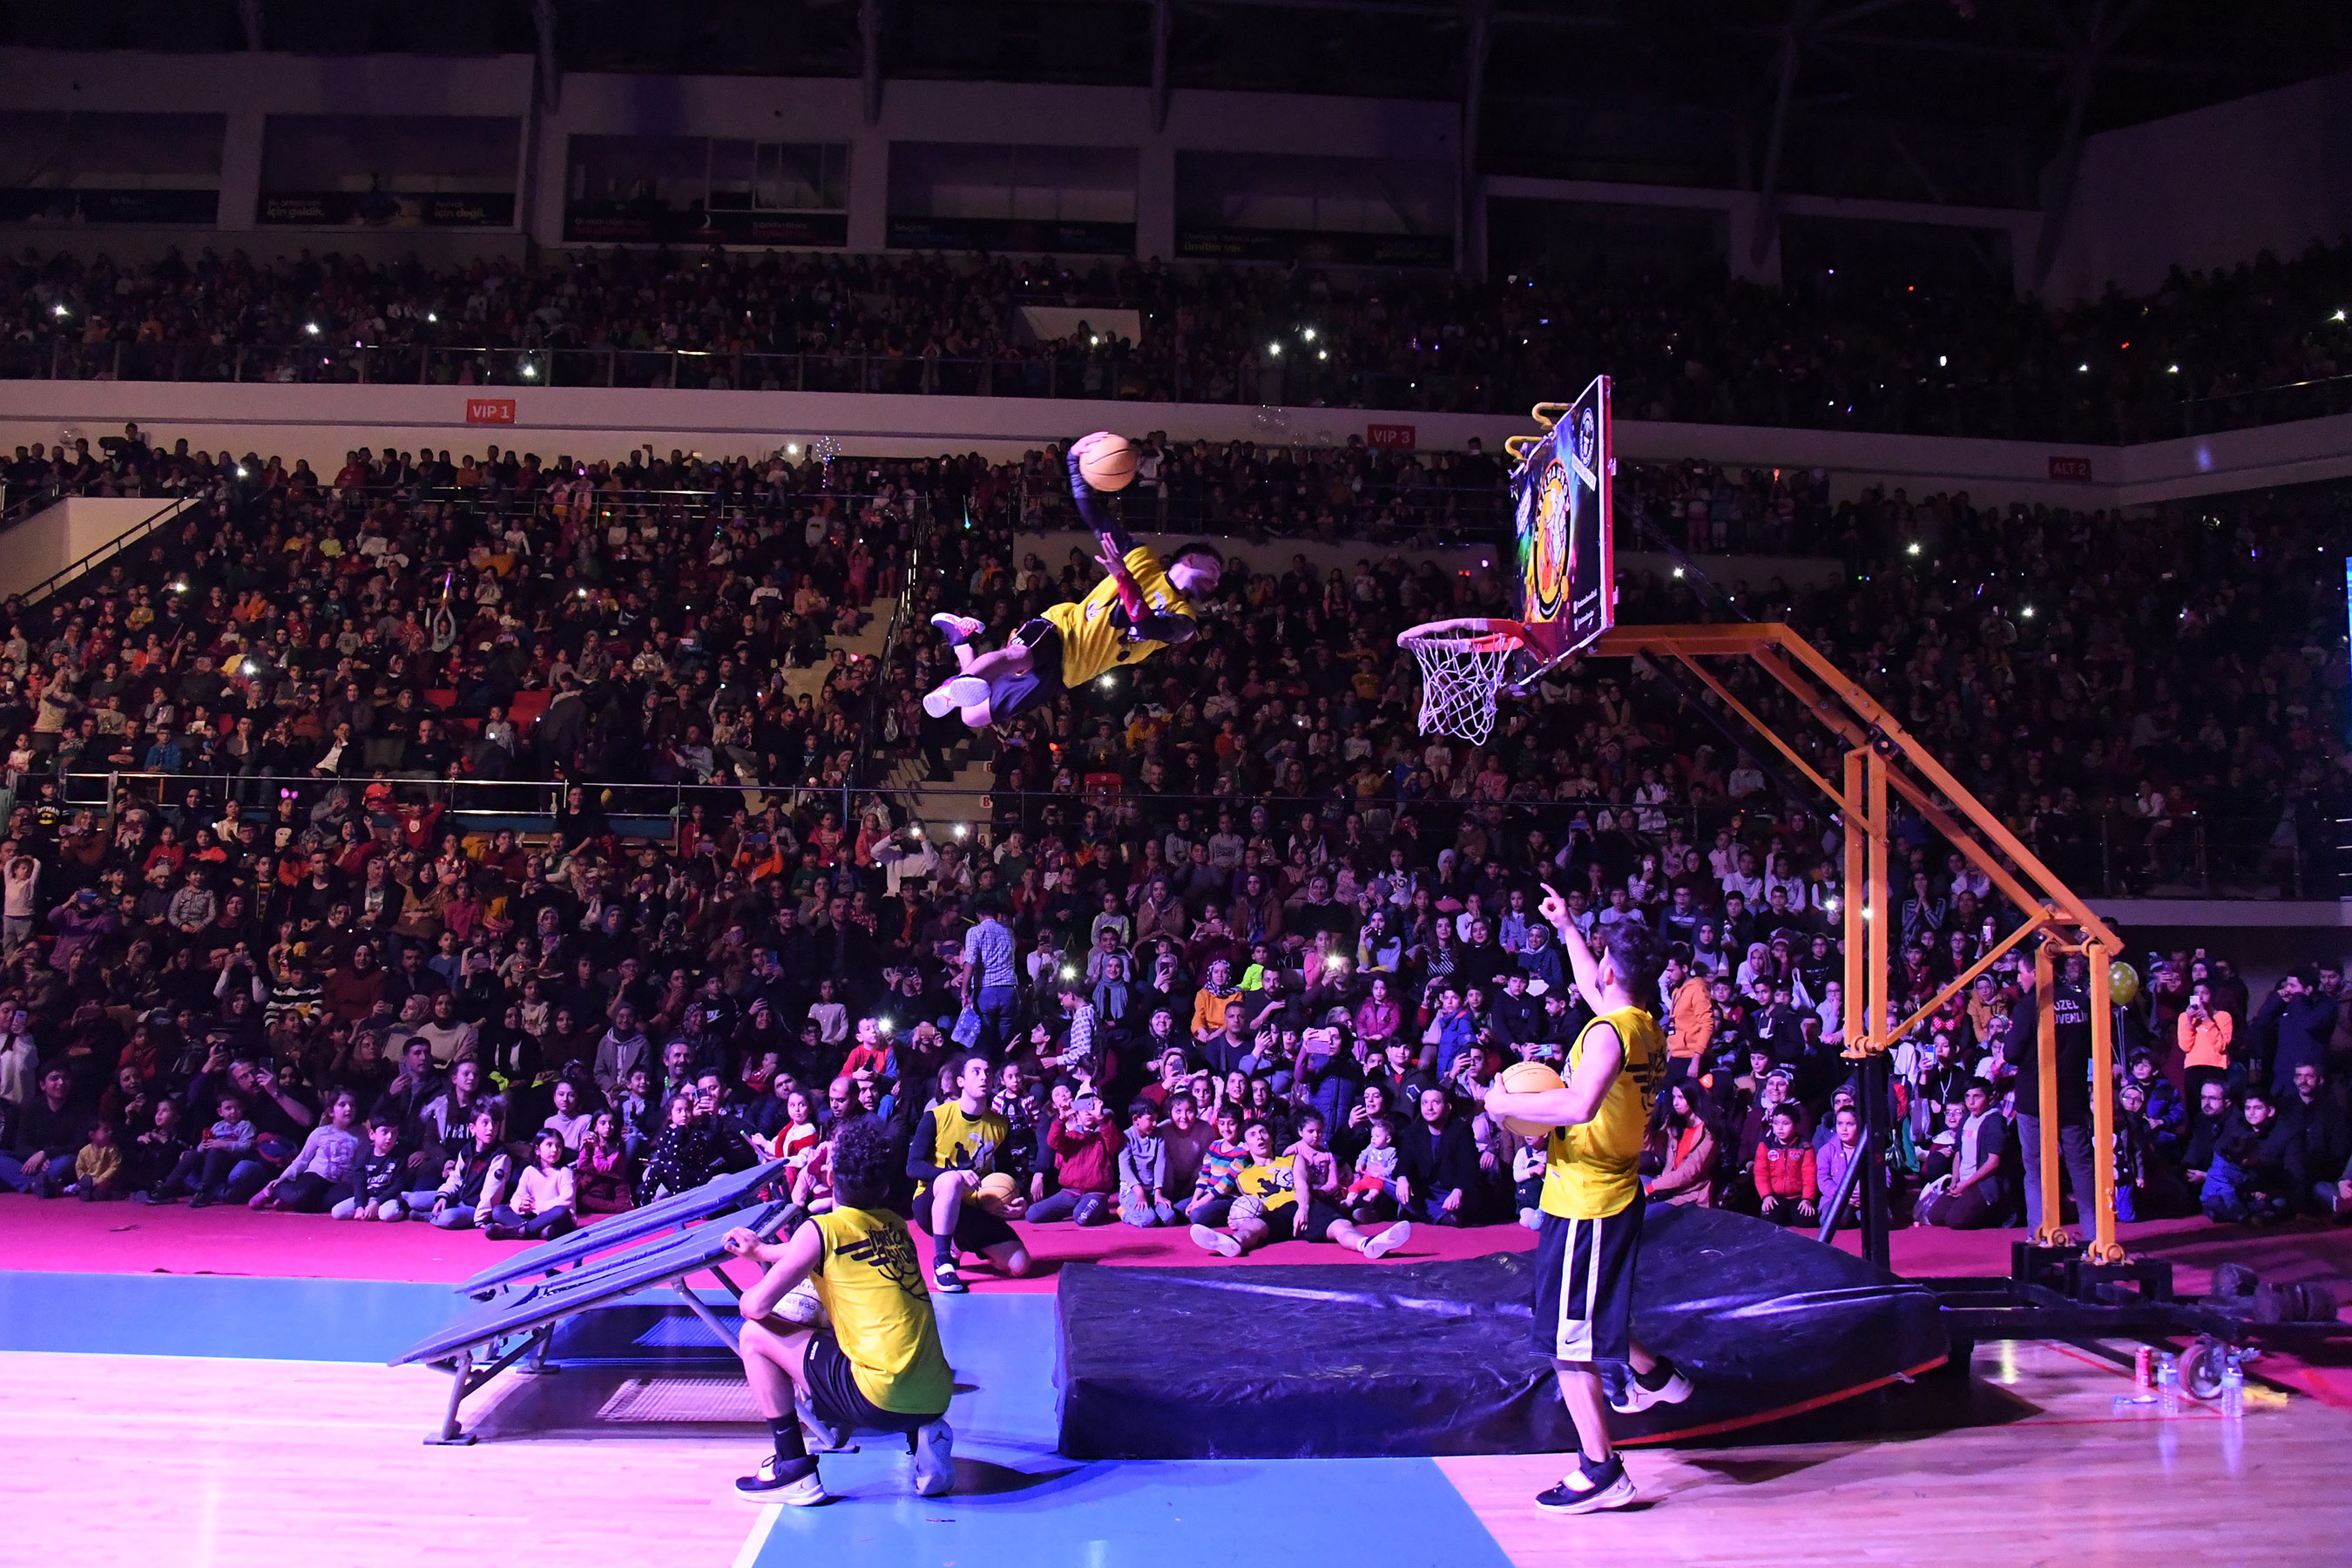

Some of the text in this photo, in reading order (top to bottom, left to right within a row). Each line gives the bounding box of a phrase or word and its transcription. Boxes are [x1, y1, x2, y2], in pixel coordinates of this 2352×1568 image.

[473, 405, 510, 419] VIP 1
[1374, 429, 1410, 443] VIP 3
[2054, 463, 2086, 476] ALT 2
[983, 796, 990, 807] B
[979, 835, 986, 845] A
